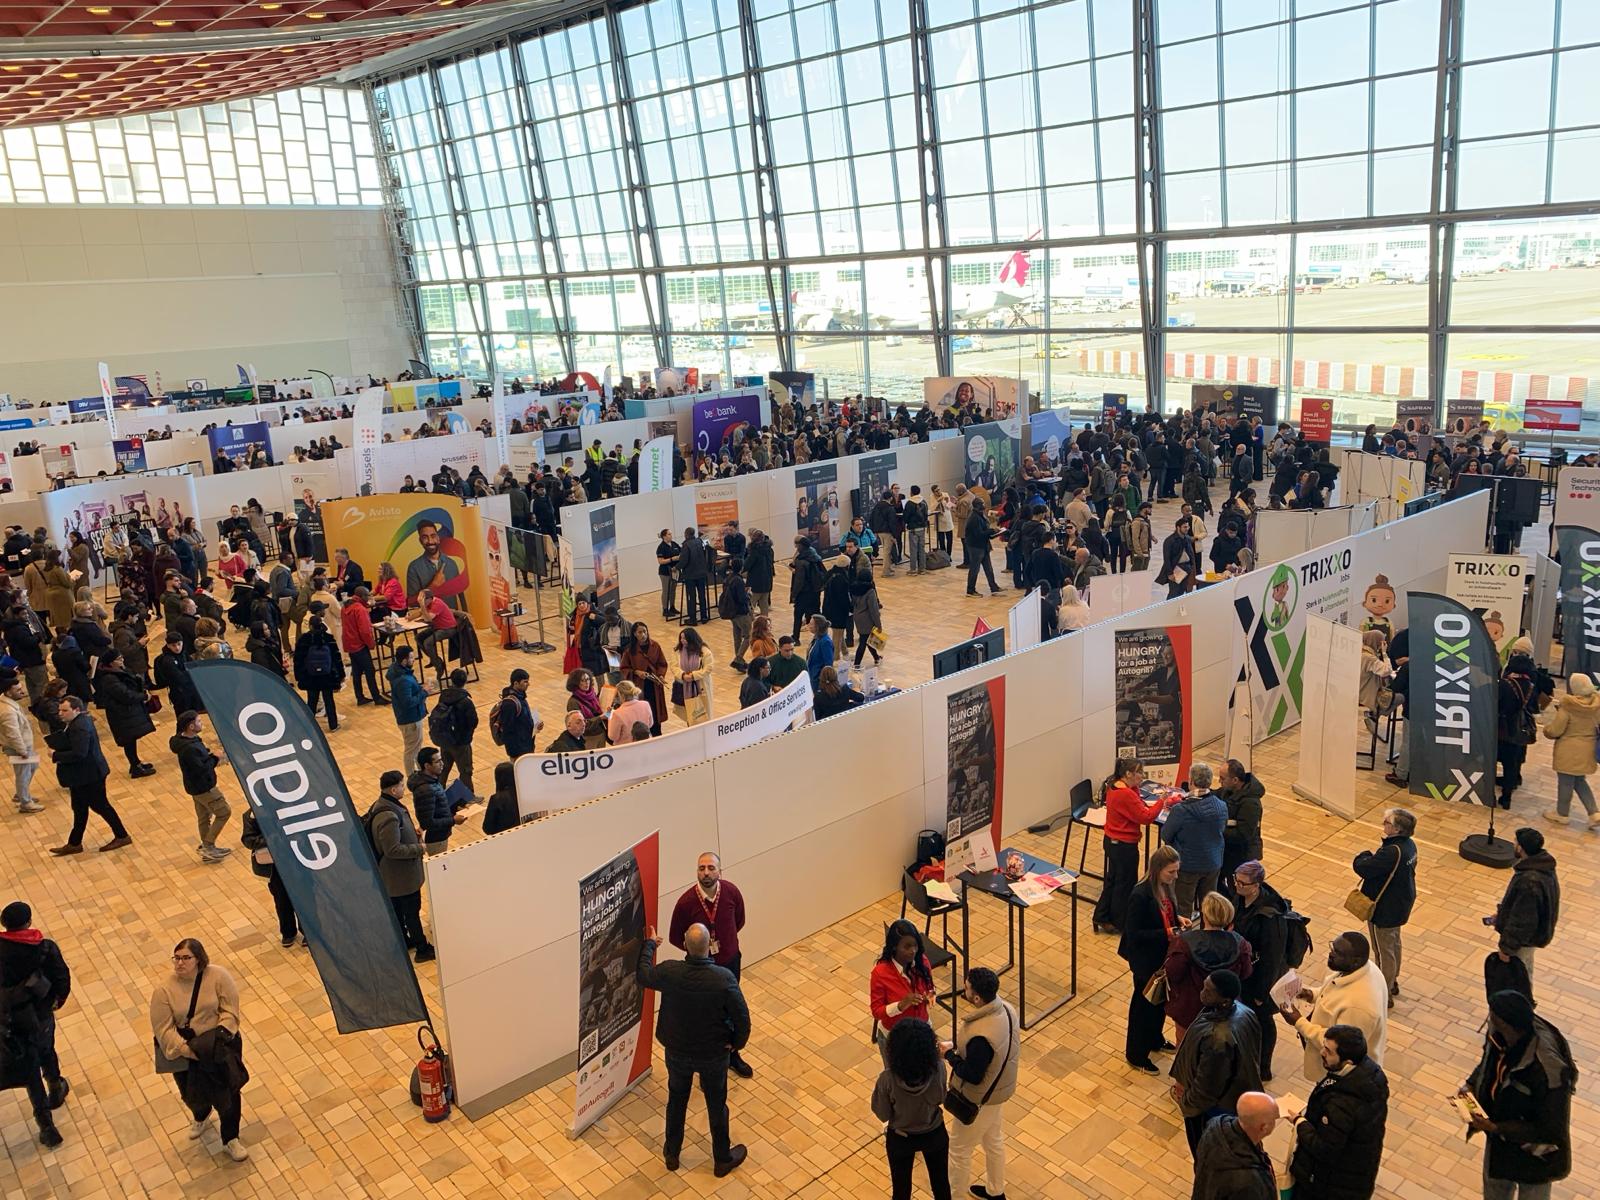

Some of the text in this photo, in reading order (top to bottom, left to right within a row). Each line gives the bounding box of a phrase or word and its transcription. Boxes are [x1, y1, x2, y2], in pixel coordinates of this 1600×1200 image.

[442, 454, 468, 463] brussels
[369, 507, 401, 516] Aviato
[1301, 549, 1351, 587] TRIXXO
[1454, 562, 1520, 577] TRIXXO
[1340, 573, 1351, 583] Jobs
[1139, 634, 1163, 642] growing
[1118, 646, 1162, 657] HUNGRY
[1118, 659, 1128, 667] for
[1135, 658, 1148, 667] job
[1118, 665, 1154, 676] Autogrill?
[717, 684, 806, 737] Reception & Office Services
[950, 703, 983, 725] HUNGRY
[949, 727, 957, 735] for
[963, 720, 973, 731] job
[973, 717, 978, 725] at
[541, 750, 614, 780] eligio
[582, 860, 631, 896] We are growing
[582, 876, 629, 917] HUNGRY
[582, 896, 622, 931] for a job at
[582, 909, 620, 944] Autogrill?
